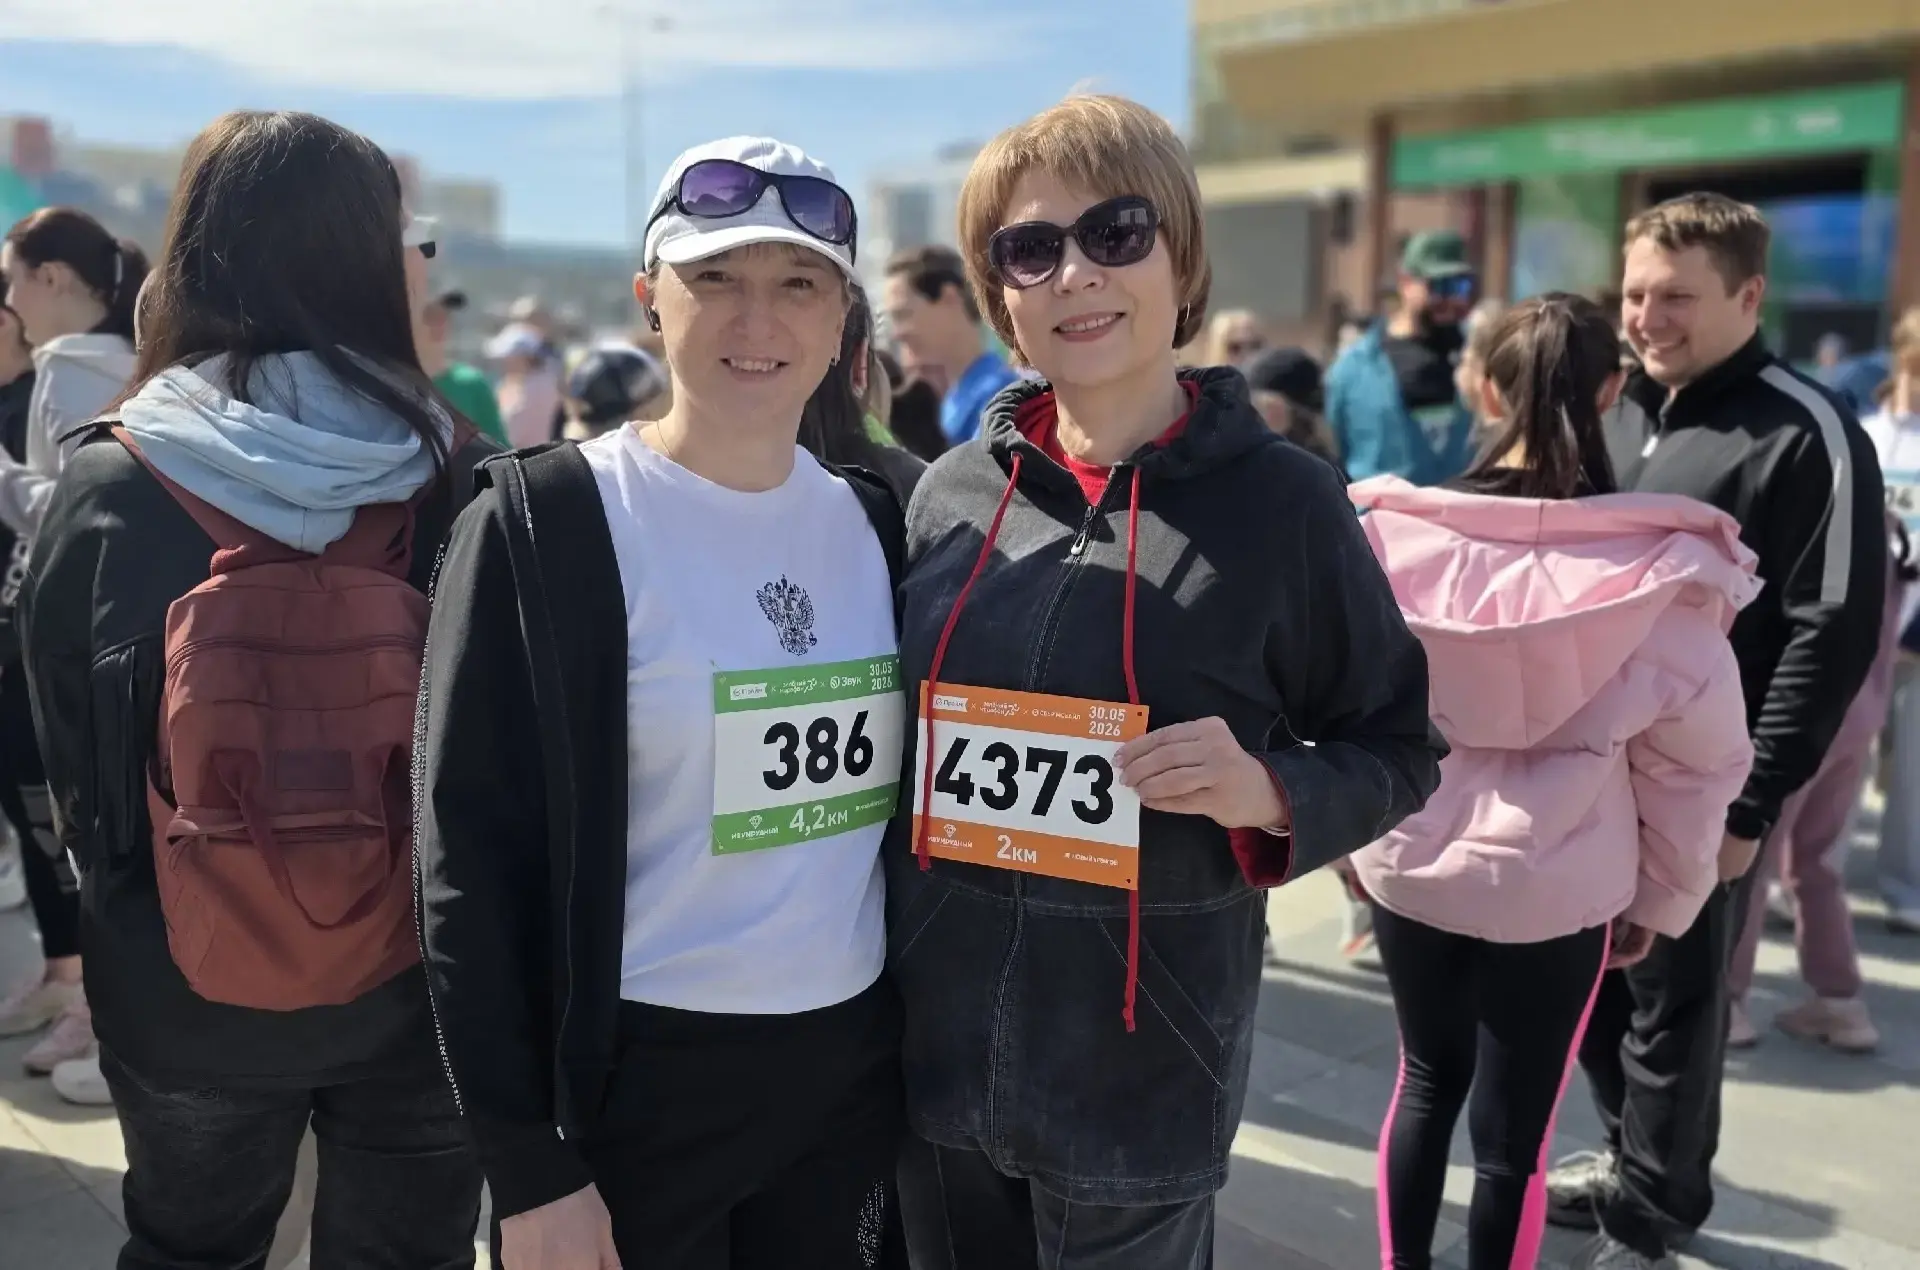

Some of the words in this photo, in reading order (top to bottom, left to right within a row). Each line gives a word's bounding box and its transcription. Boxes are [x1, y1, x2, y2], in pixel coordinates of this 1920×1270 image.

[869, 662, 893, 676] 30.05
[841, 676, 862, 688] Звук
[871, 676, 893, 691] 2026
[1088, 705, 1127, 722] 30.05
[1088, 721, 1121, 736] 2026
[762, 709, 874, 791] 386
[933, 736, 1114, 825] 4373
